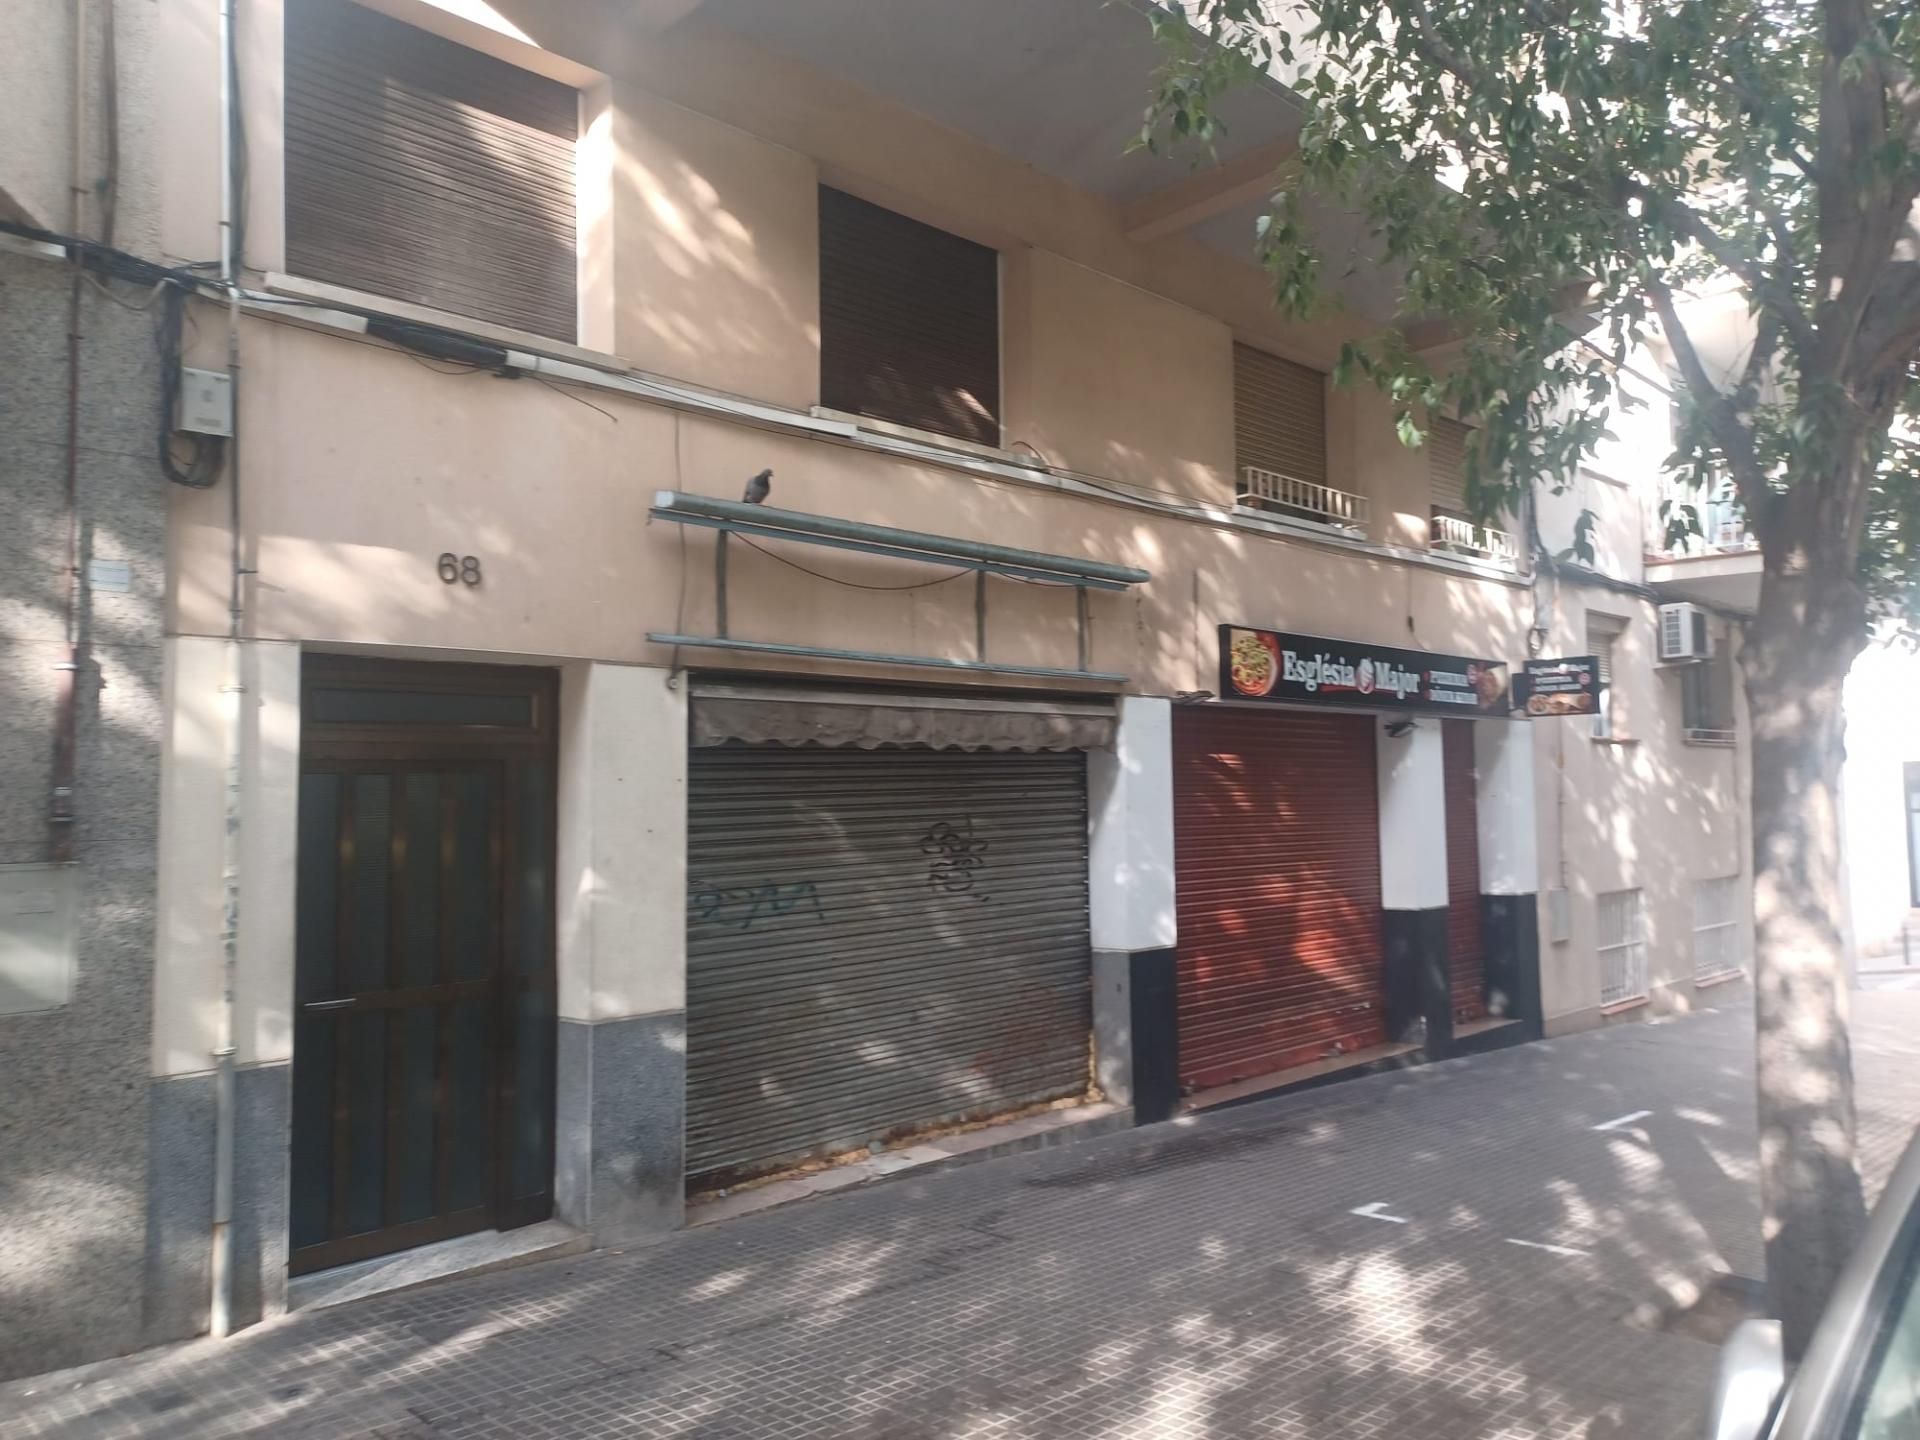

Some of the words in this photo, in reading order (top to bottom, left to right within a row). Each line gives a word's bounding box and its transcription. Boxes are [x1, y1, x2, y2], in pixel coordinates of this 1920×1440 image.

[438, 553, 482, 586] 68
[1281, 650, 1356, 692] Església
[1373, 661, 1420, 700] Major
